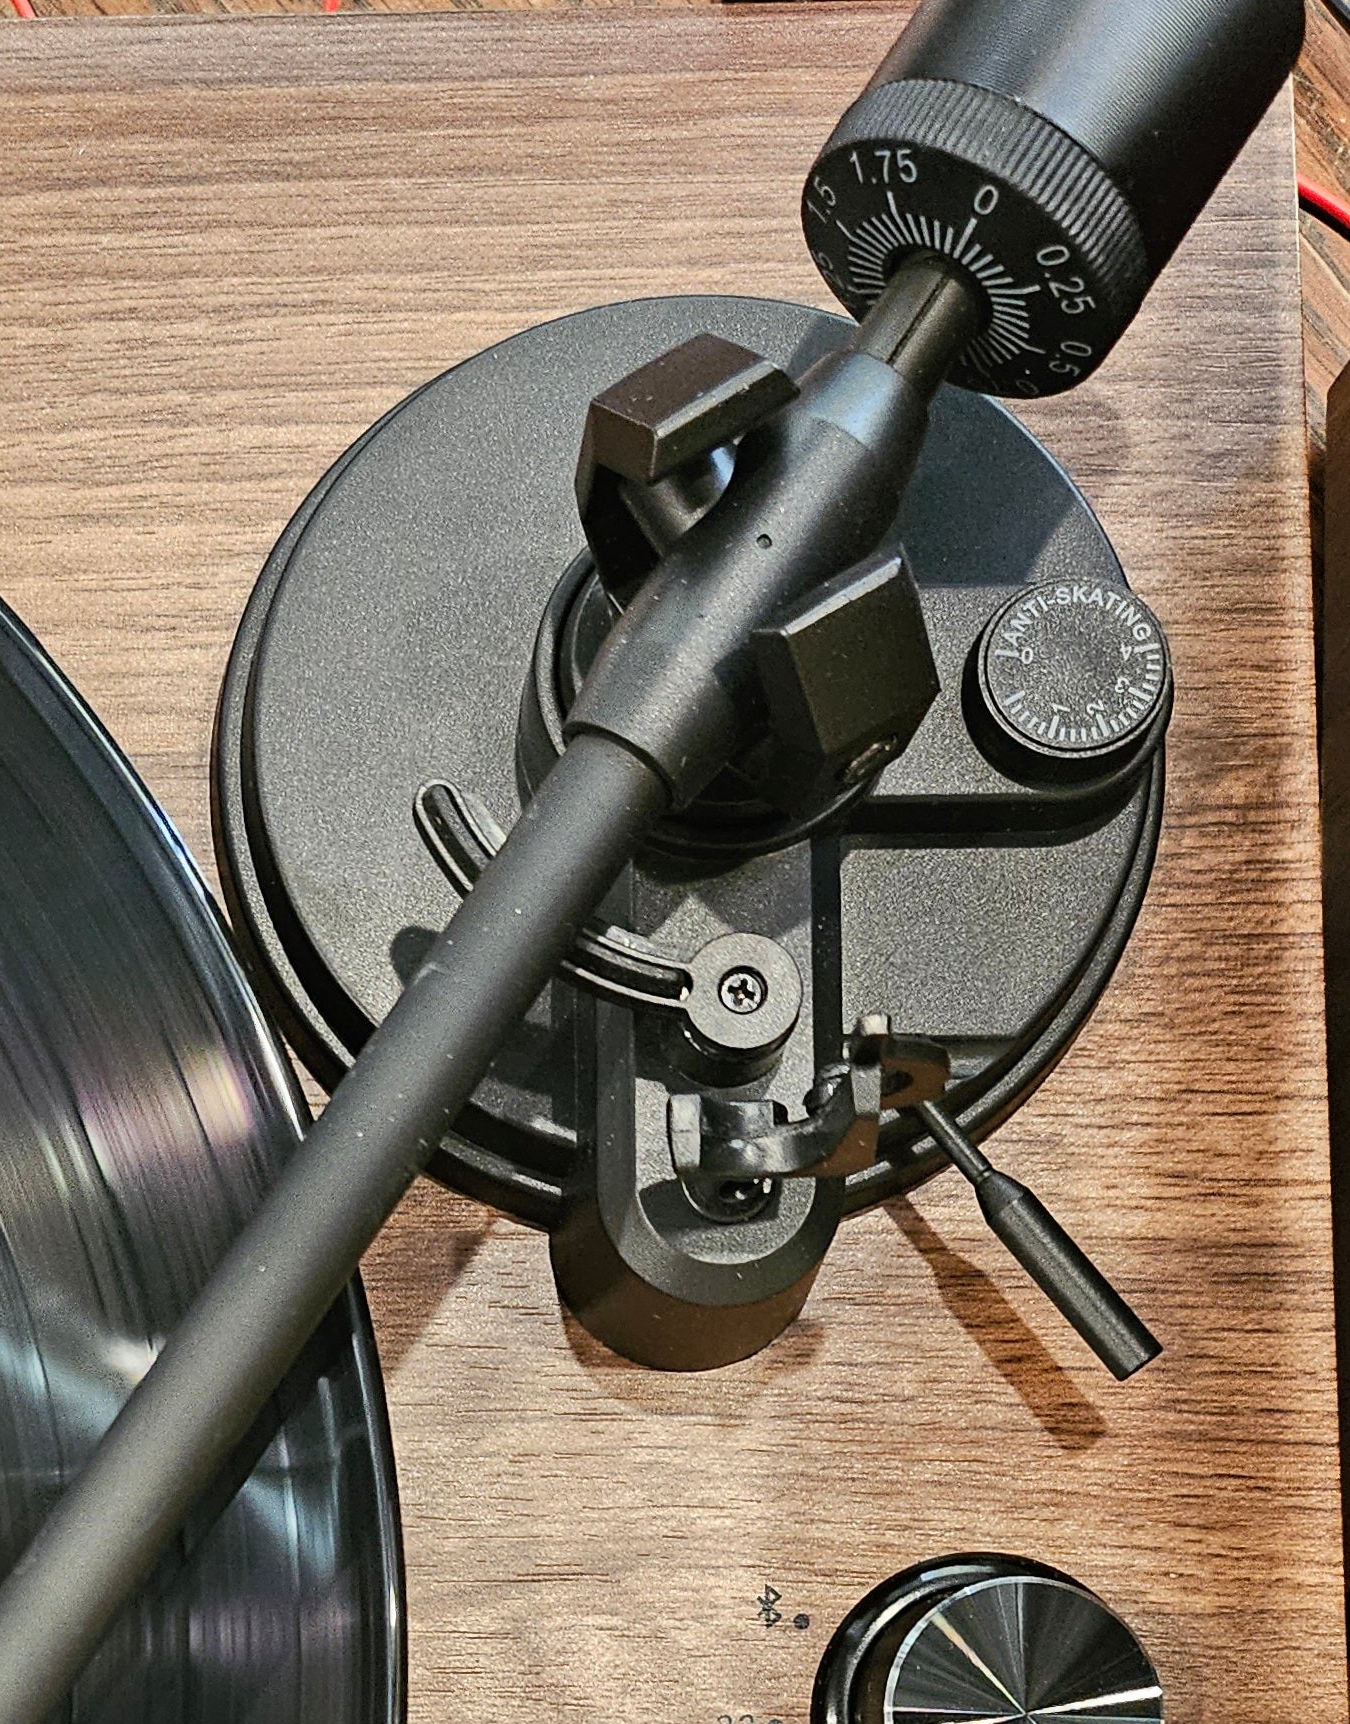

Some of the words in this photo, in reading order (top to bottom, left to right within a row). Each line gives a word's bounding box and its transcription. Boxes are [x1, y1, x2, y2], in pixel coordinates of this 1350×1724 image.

[850, 149, 918, 185] 1.75
[806, 176, 837, 225] 1.5
[973, 184, 999, 216] 0
[1036, 245, 1096, 314] 0.25
[1048, 340, 1092, 377] 0.5
[1002, 585, 1152, 649] ANTI-SKATING
